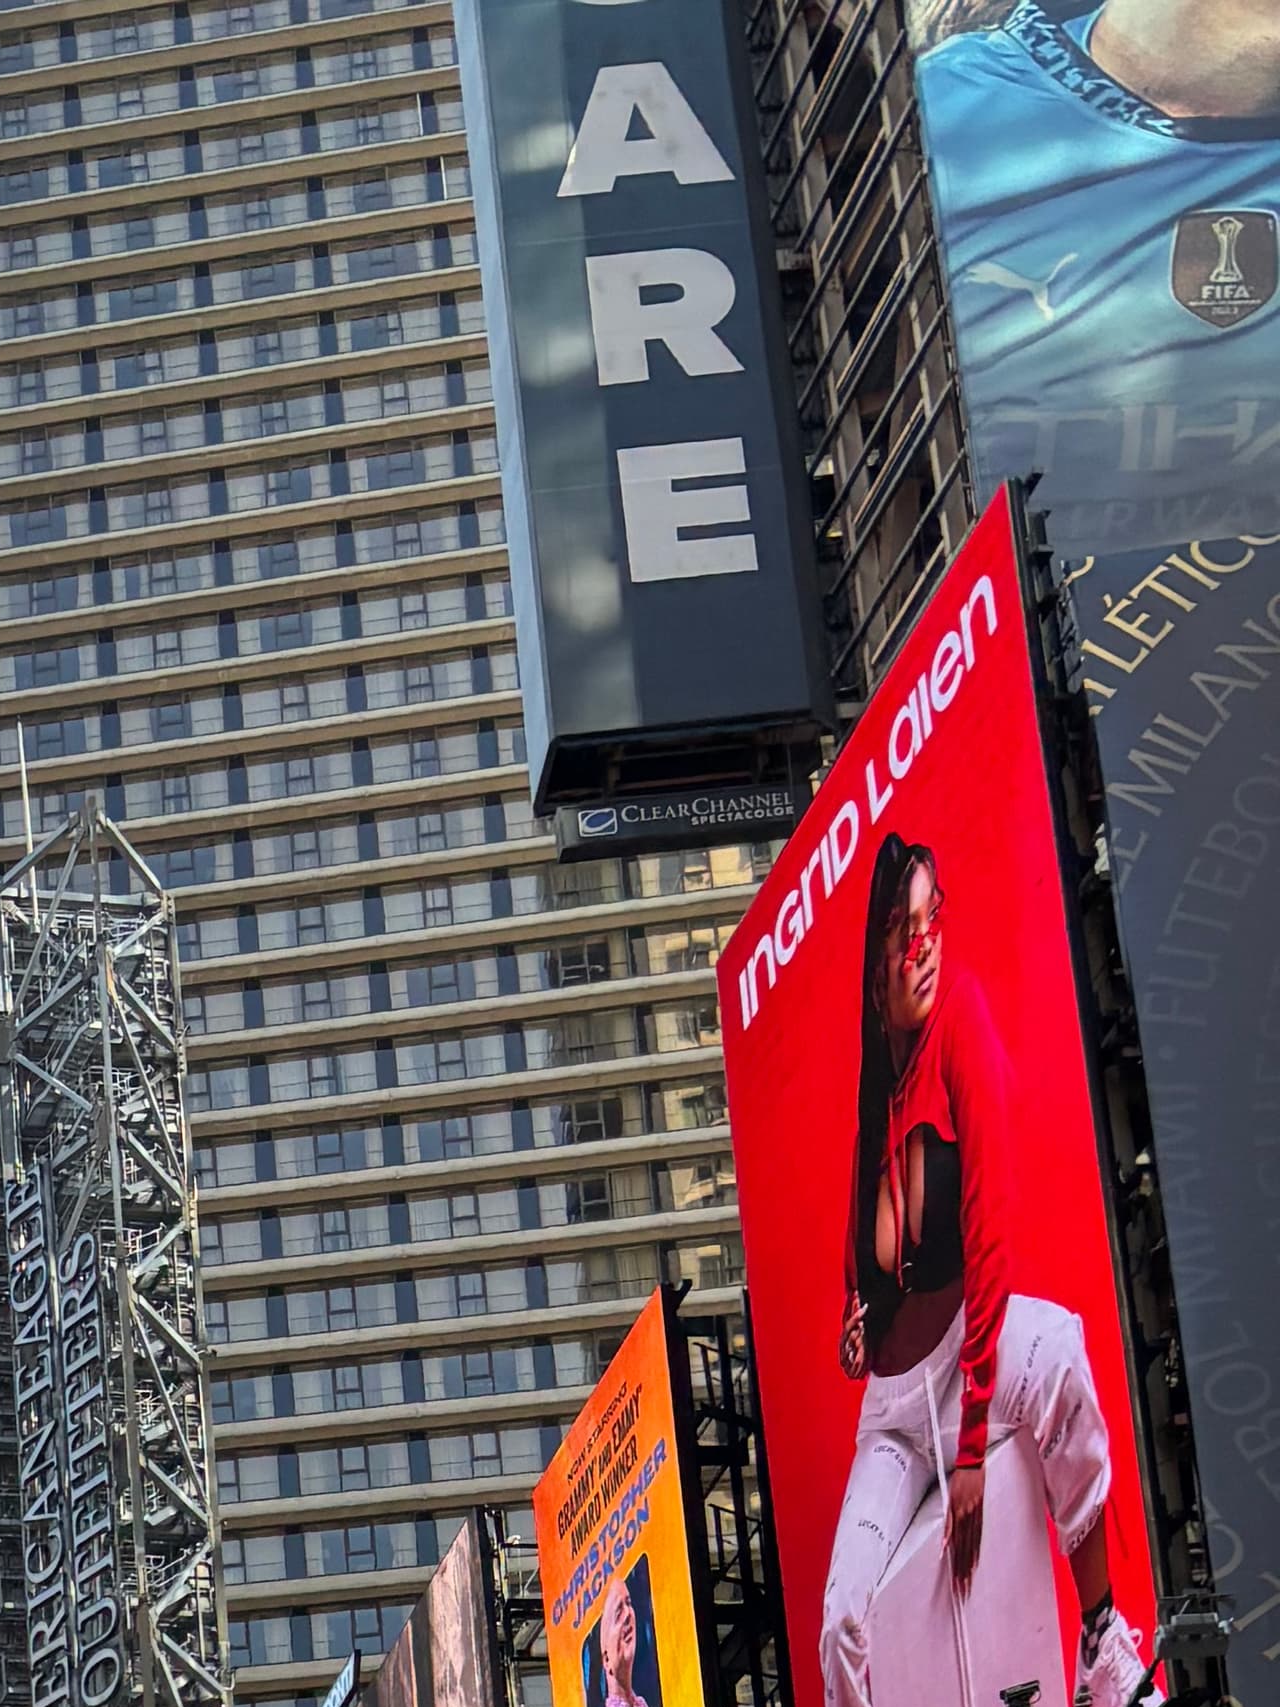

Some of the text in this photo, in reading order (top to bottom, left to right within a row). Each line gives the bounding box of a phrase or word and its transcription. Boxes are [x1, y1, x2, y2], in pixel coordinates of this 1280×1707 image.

[557, 0, 759, 585] ARE
[1201, 285, 1251, 299] FIFA
[691, 805, 795, 826] SPECTACOLOR
[567, 1380, 629, 1486] NOW STARRING
[552, 1438, 668, 1628] CHRISTOPHER
[571, 1435, 639, 1561] AWARD WINNER
[573, 1496, 651, 1630] JACKSON
